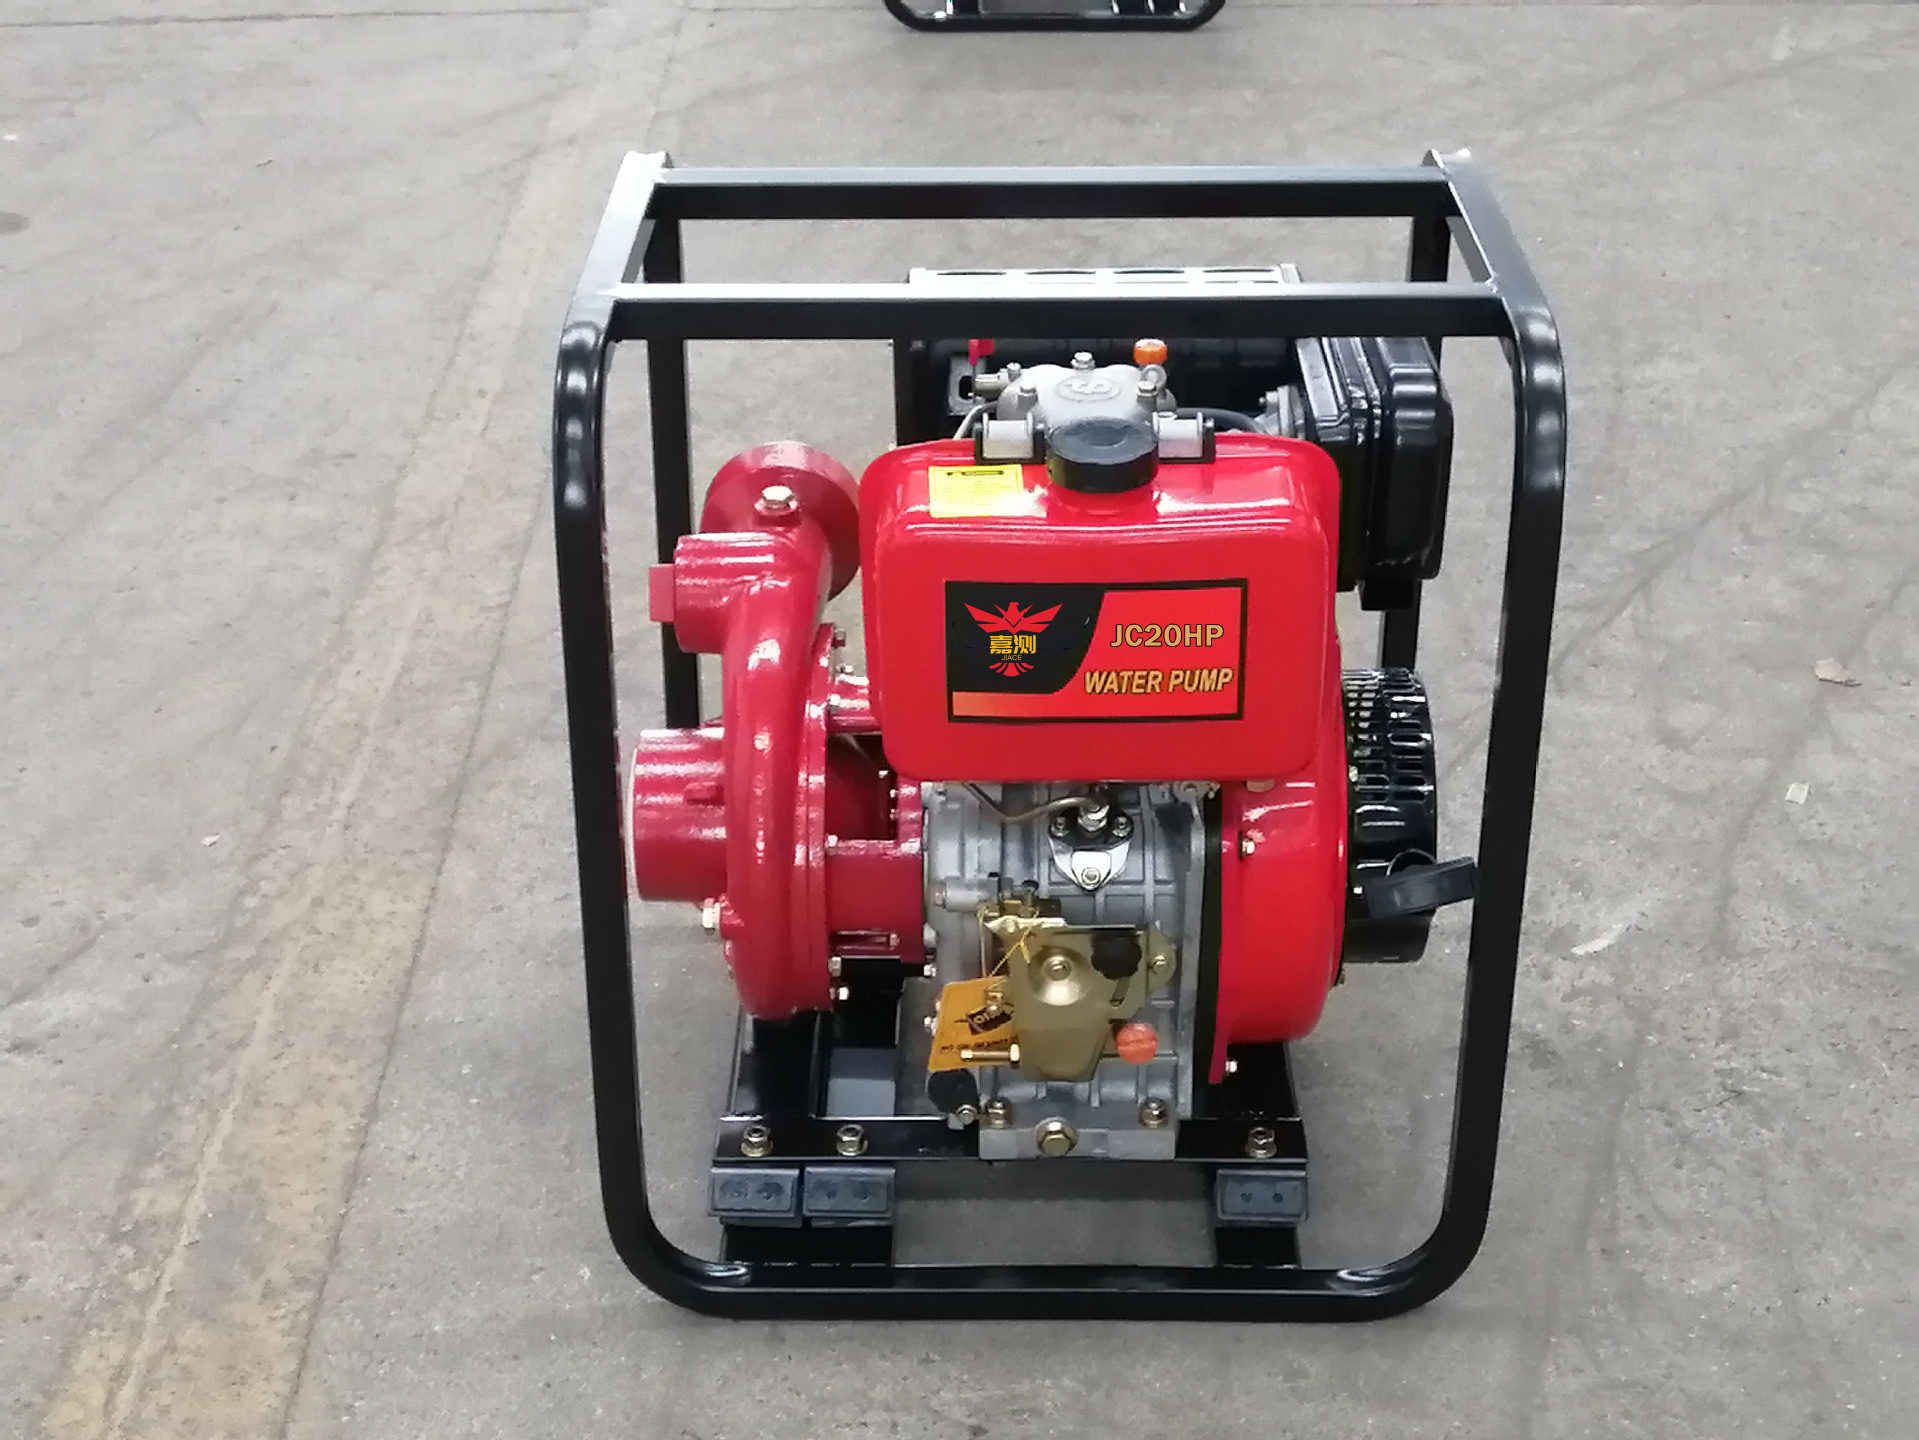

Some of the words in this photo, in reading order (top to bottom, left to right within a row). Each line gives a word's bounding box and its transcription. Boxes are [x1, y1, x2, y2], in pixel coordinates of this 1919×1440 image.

[989, 634, 1037, 654] 嘉测
[1110, 623, 1224, 647] JC20HP
[1084, 669, 1163, 694] WATER
[1168, 667, 1234, 693] PUMP
